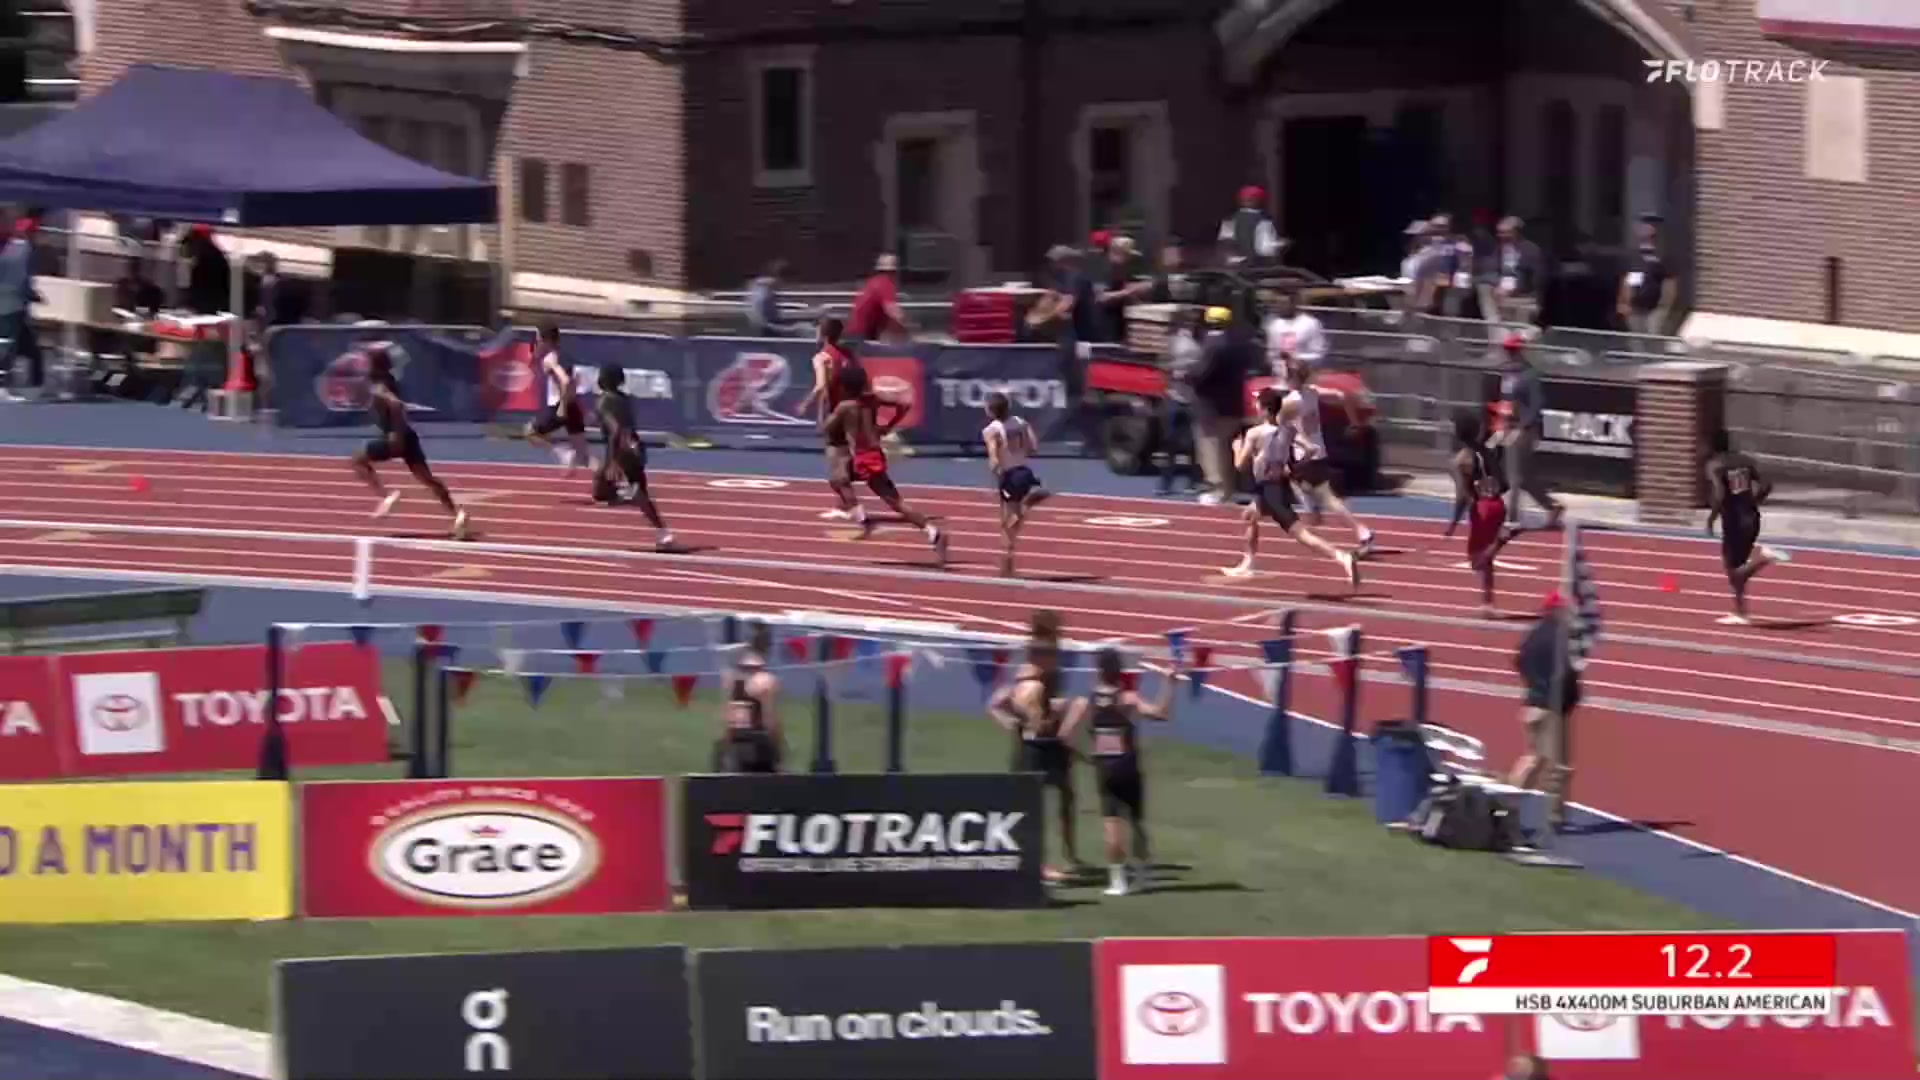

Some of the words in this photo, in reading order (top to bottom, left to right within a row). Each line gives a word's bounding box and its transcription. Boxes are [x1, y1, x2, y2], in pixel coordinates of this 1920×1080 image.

[172, 686, 368, 727] TOYOTA
[32, 825, 68, 876] A
[83, 823, 257, 875] MONTH
[741, 811, 1026, 854] FLOTRACK
[405, 837, 566, 874] Grace
[746, 1006, 834, 1043] Run
[837, 1012, 894, 1039] on
[897, 1000, 1053, 1038] clouds.
